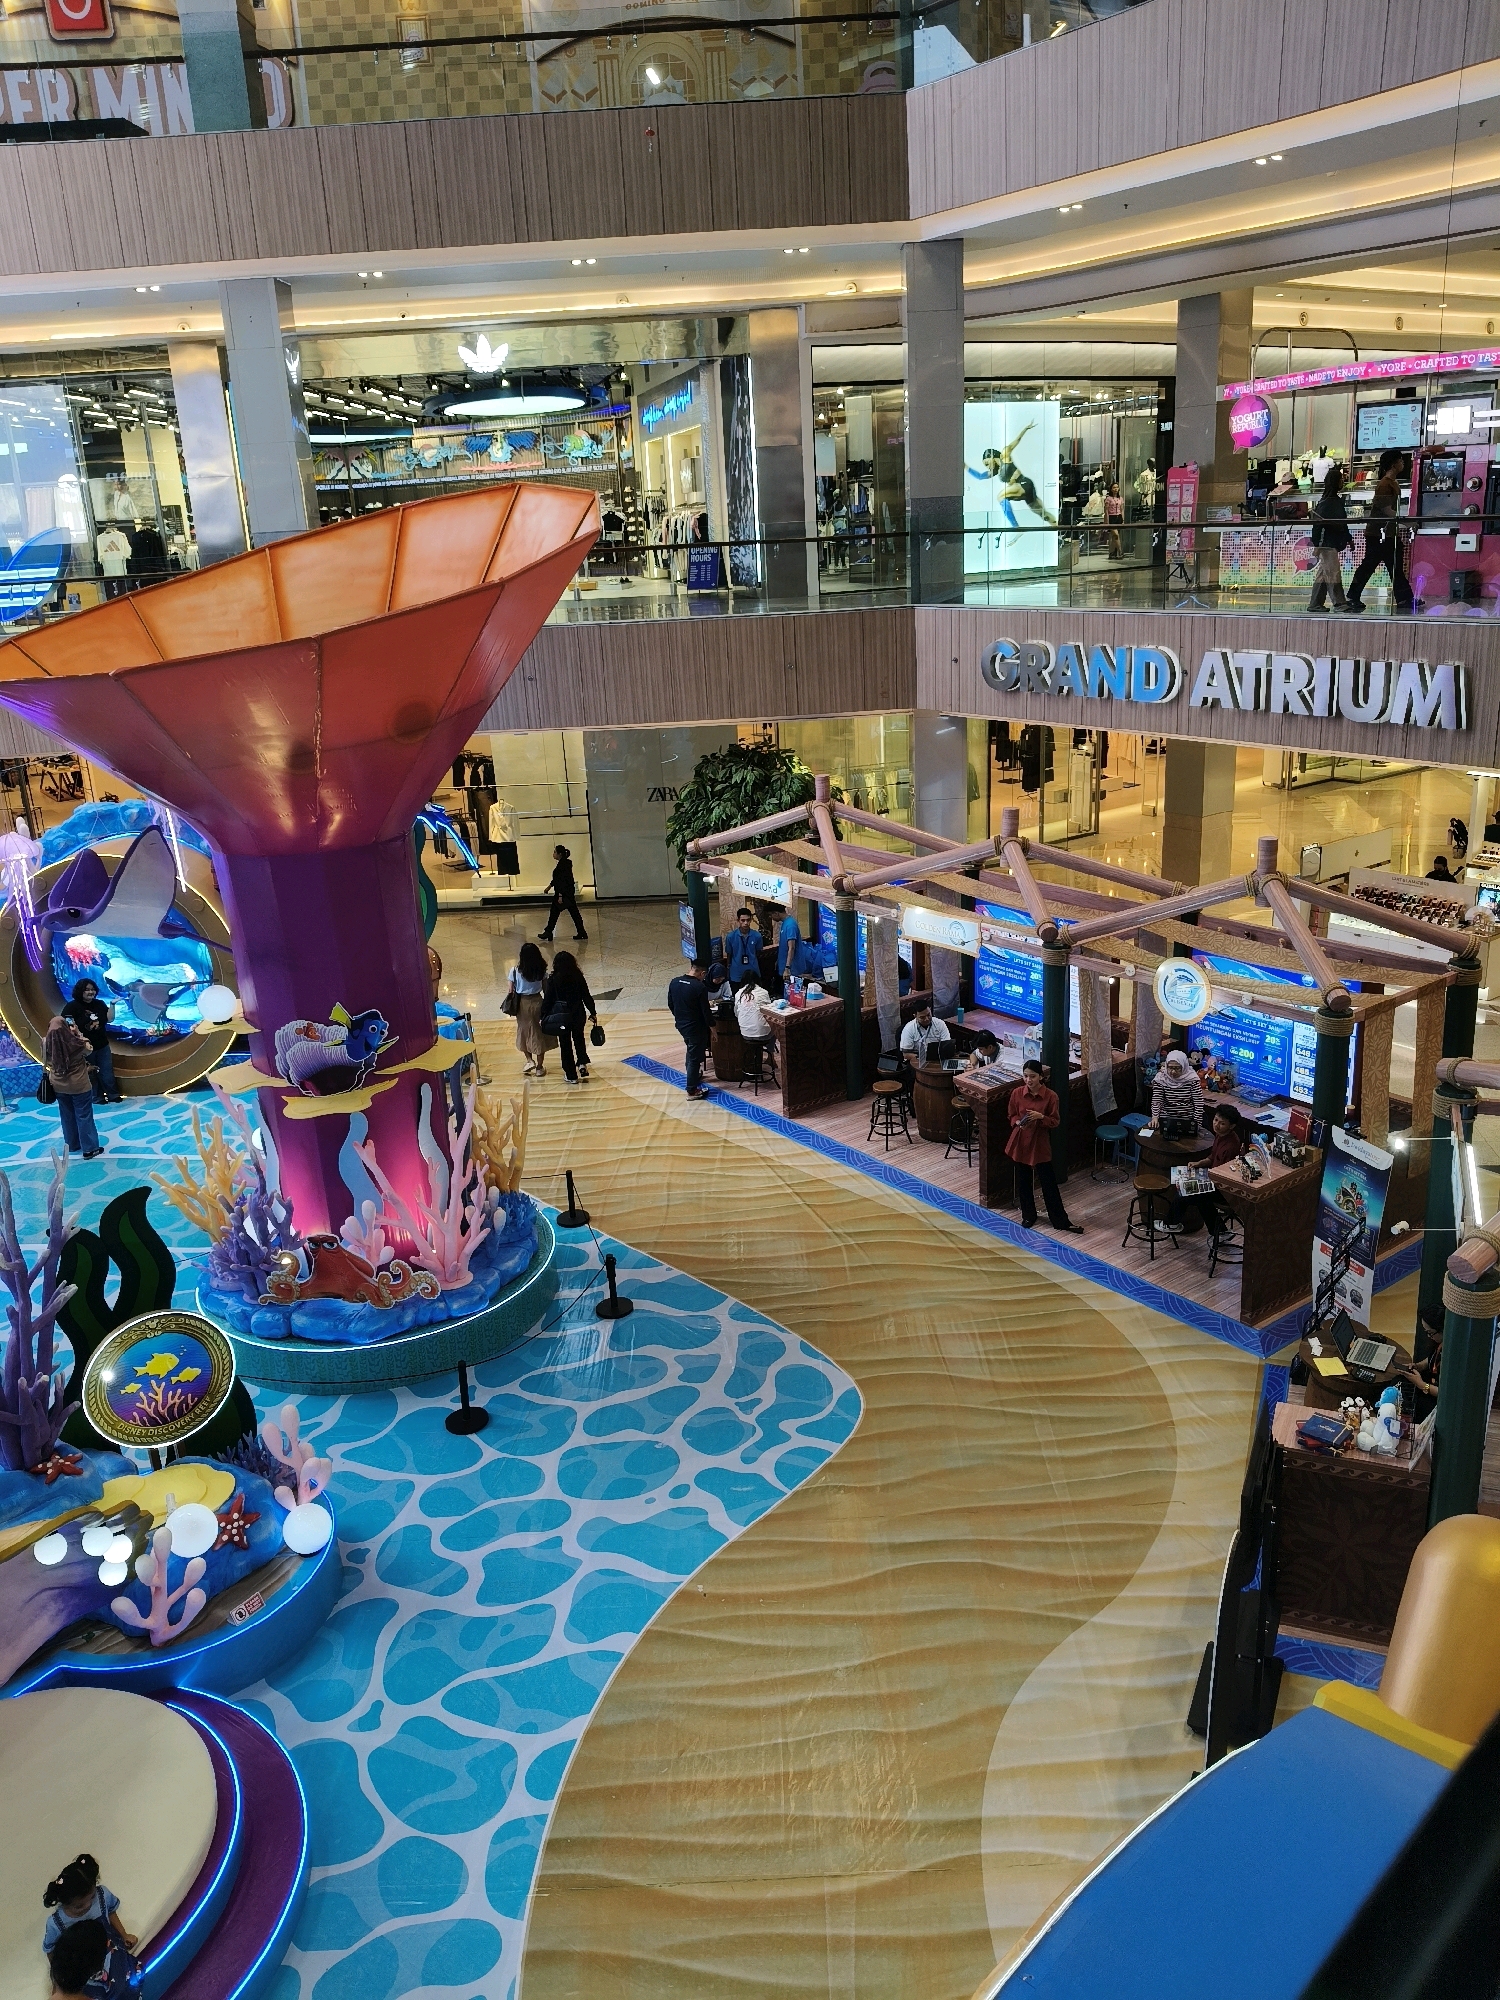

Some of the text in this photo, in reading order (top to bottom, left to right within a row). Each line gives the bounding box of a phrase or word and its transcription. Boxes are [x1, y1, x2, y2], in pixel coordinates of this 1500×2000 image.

[0, 68, 70, 124] ER
[1337, 366, 1366, 377] ENJOY
[1381, 362, 1406, 372] YORE
[1414, 356, 1459, 369] CRAFTED
[1461, 354, 1476, 364] TO
[1231, 409, 1269, 425] YOGURT
[1232, 418, 1269, 434] REPUBLIC
[691, 554, 711, 562] HOURS
[981, 637, 1467, 730] GRAND ATRIUM
[646, 786, 679, 802] ZARA
[738, 875, 777, 893] traveloka
[117, 1395, 212, 1436] DISNEY DISCOVERY REEF
